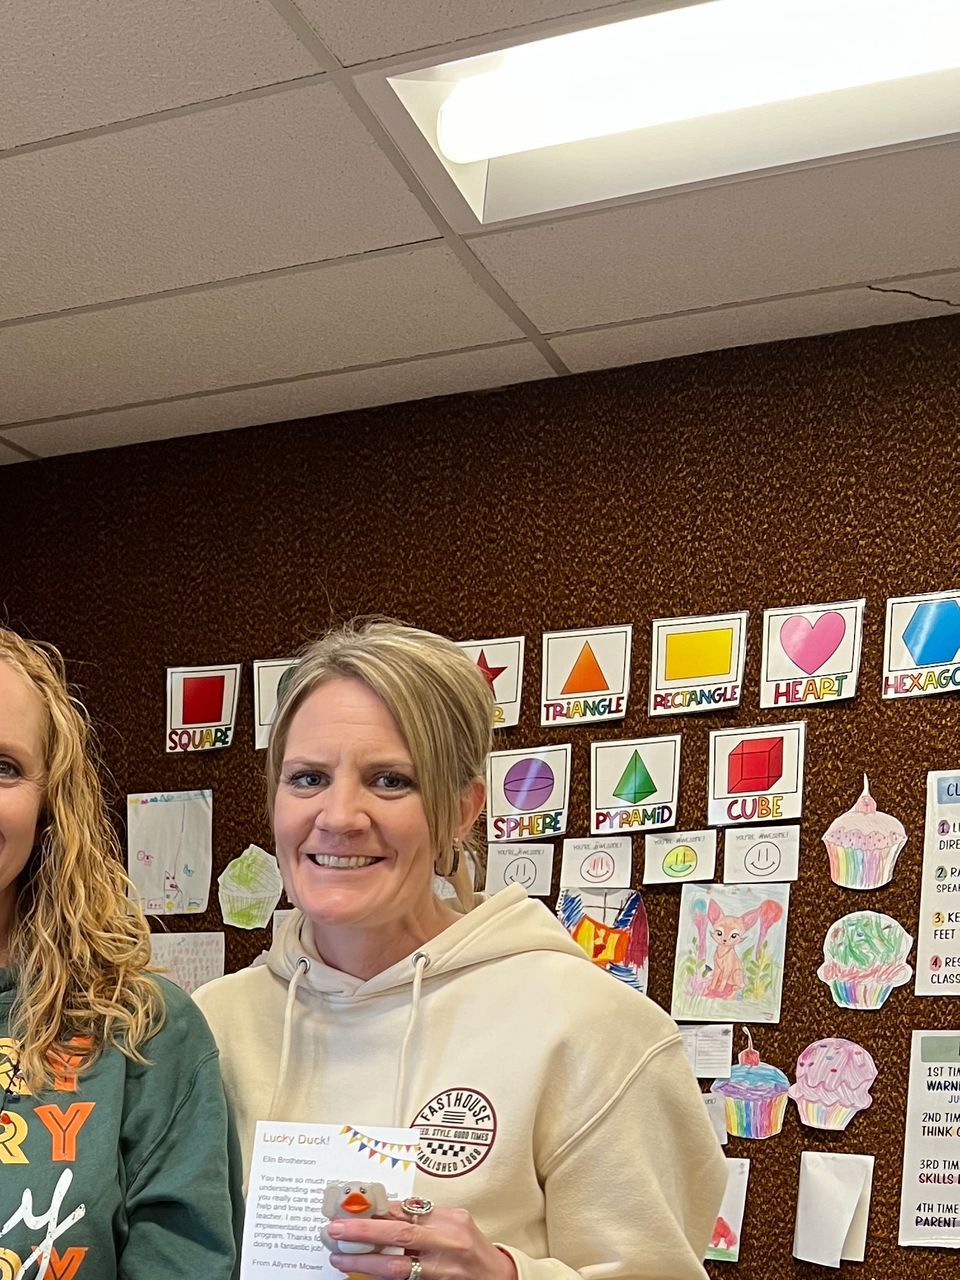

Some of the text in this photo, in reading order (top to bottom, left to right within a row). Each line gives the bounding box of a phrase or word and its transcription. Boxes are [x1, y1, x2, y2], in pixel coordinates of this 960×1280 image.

[774, 674, 848, 705] HEART
[653, 685, 740, 711] RECTANGLE
[168, 726, 233, 752] SQUARE
[727, 795, 784, 821] CUBE
[493, 811, 563, 840] SPHERE
[934, 928, 956, 940] FEET
[928, 1066, 944, 1077] 1ST
[420, 1092, 491, 1125] FASTHOUSE
[922, 1112, 941, 1123] 2ND
[470, 1131, 489, 1142] TIMES
[921, 1125, 953, 1137] THINK
[263, 1132, 330, 1146] Lucky Duck!
[919, 1159, 939, 1170] 3RD
[260, 1174, 274, 1182] You
[276, 1175, 293, 1183] have
[918, 1173, 954, 1185] SKILLS
[259, 1185, 308, 1195] understanding
[272, 1195, 292, 1203] really
[915, 1203, 959, 1214] 4TH TIME
[255, 1223, 307, 1231] implementation
[915, 1216, 957, 1228] PARENT
[287, 1233, 312, 1241] Thanks
[253, 1241, 272, 1249] doing
[280, 1242, 310, 1251] fantastic
